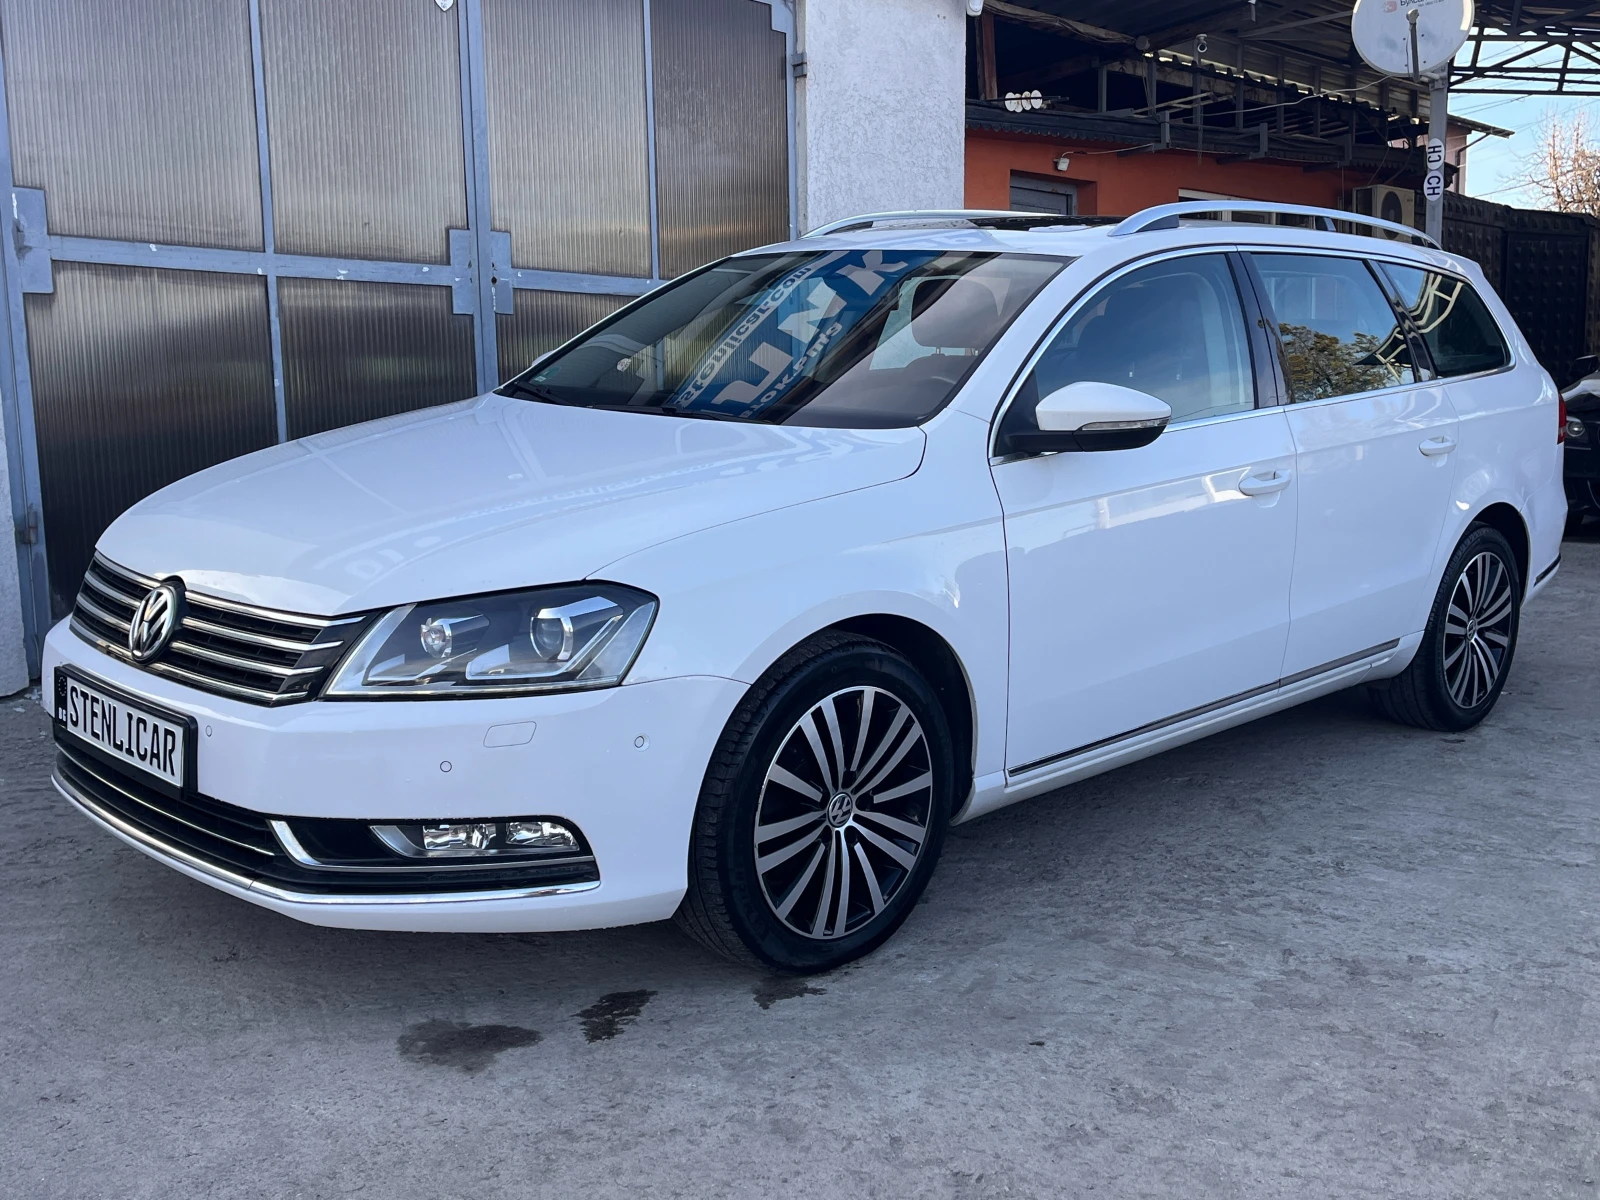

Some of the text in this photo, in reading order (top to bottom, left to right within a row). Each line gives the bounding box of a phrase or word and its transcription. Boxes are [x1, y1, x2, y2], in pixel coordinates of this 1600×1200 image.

[1428, 145, 1442, 163] CH
[1427, 175, 1441, 196] CH
[69, 685, 177, 777] STENLICAR
